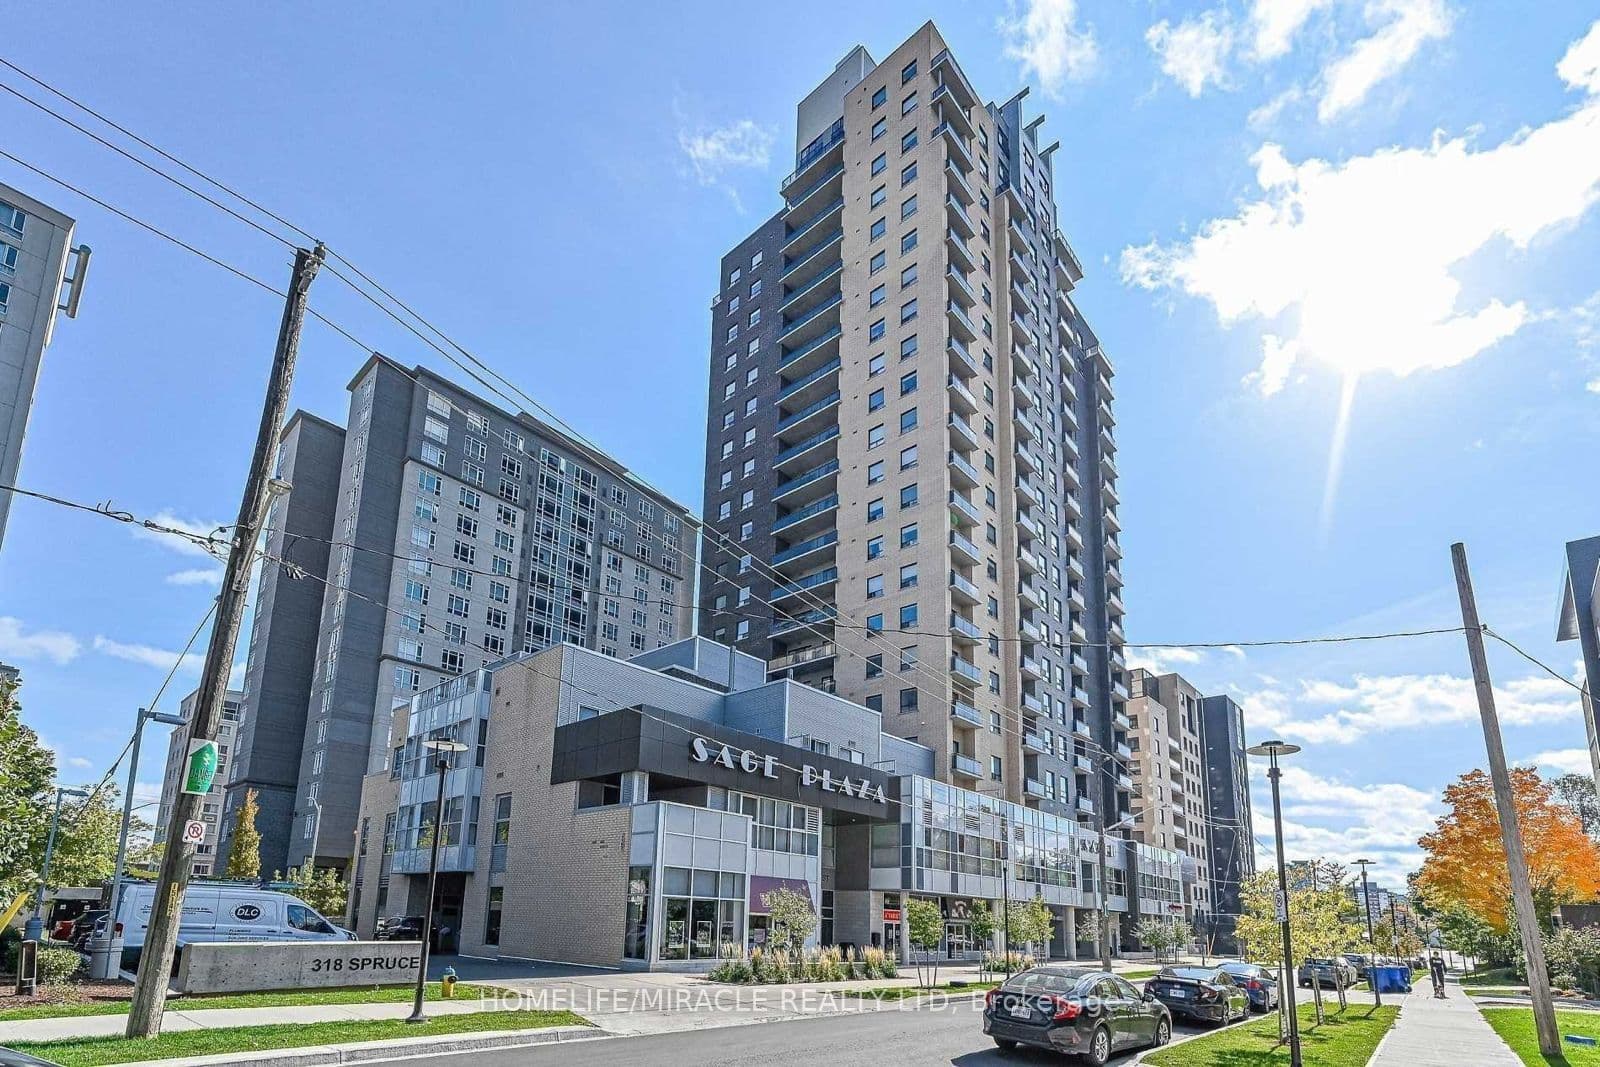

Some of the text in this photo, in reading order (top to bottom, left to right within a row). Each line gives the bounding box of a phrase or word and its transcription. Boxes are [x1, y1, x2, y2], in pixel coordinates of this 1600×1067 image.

[692, 737, 886, 804] SAGE PLAZA
[236, 908, 259, 917] DLC
[312, 956, 420, 972] 318 SPRUCE
